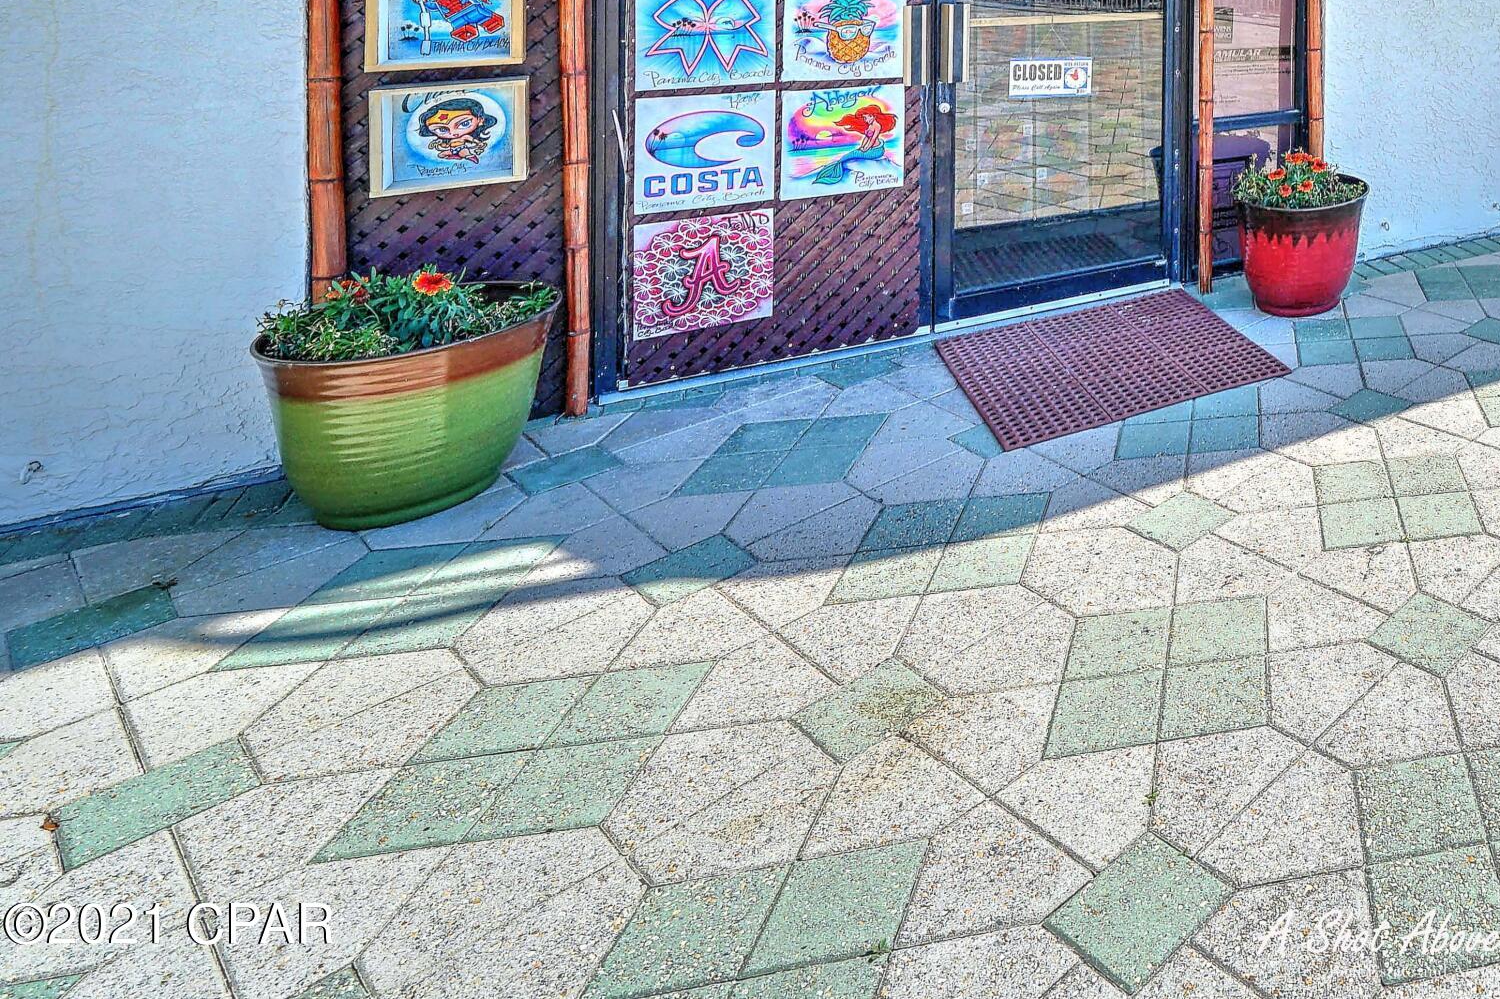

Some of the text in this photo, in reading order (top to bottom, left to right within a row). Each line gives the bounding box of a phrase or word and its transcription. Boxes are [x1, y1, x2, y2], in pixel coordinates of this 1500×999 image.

[794, 43, 832, 72] Panama
[1214, 48, 1261, 60] AMULAR
[643, 70, 697, 88] Panama
[1012, 64, 1062, 81] CLOSED
[643, 166, 764, 198] COSTA
